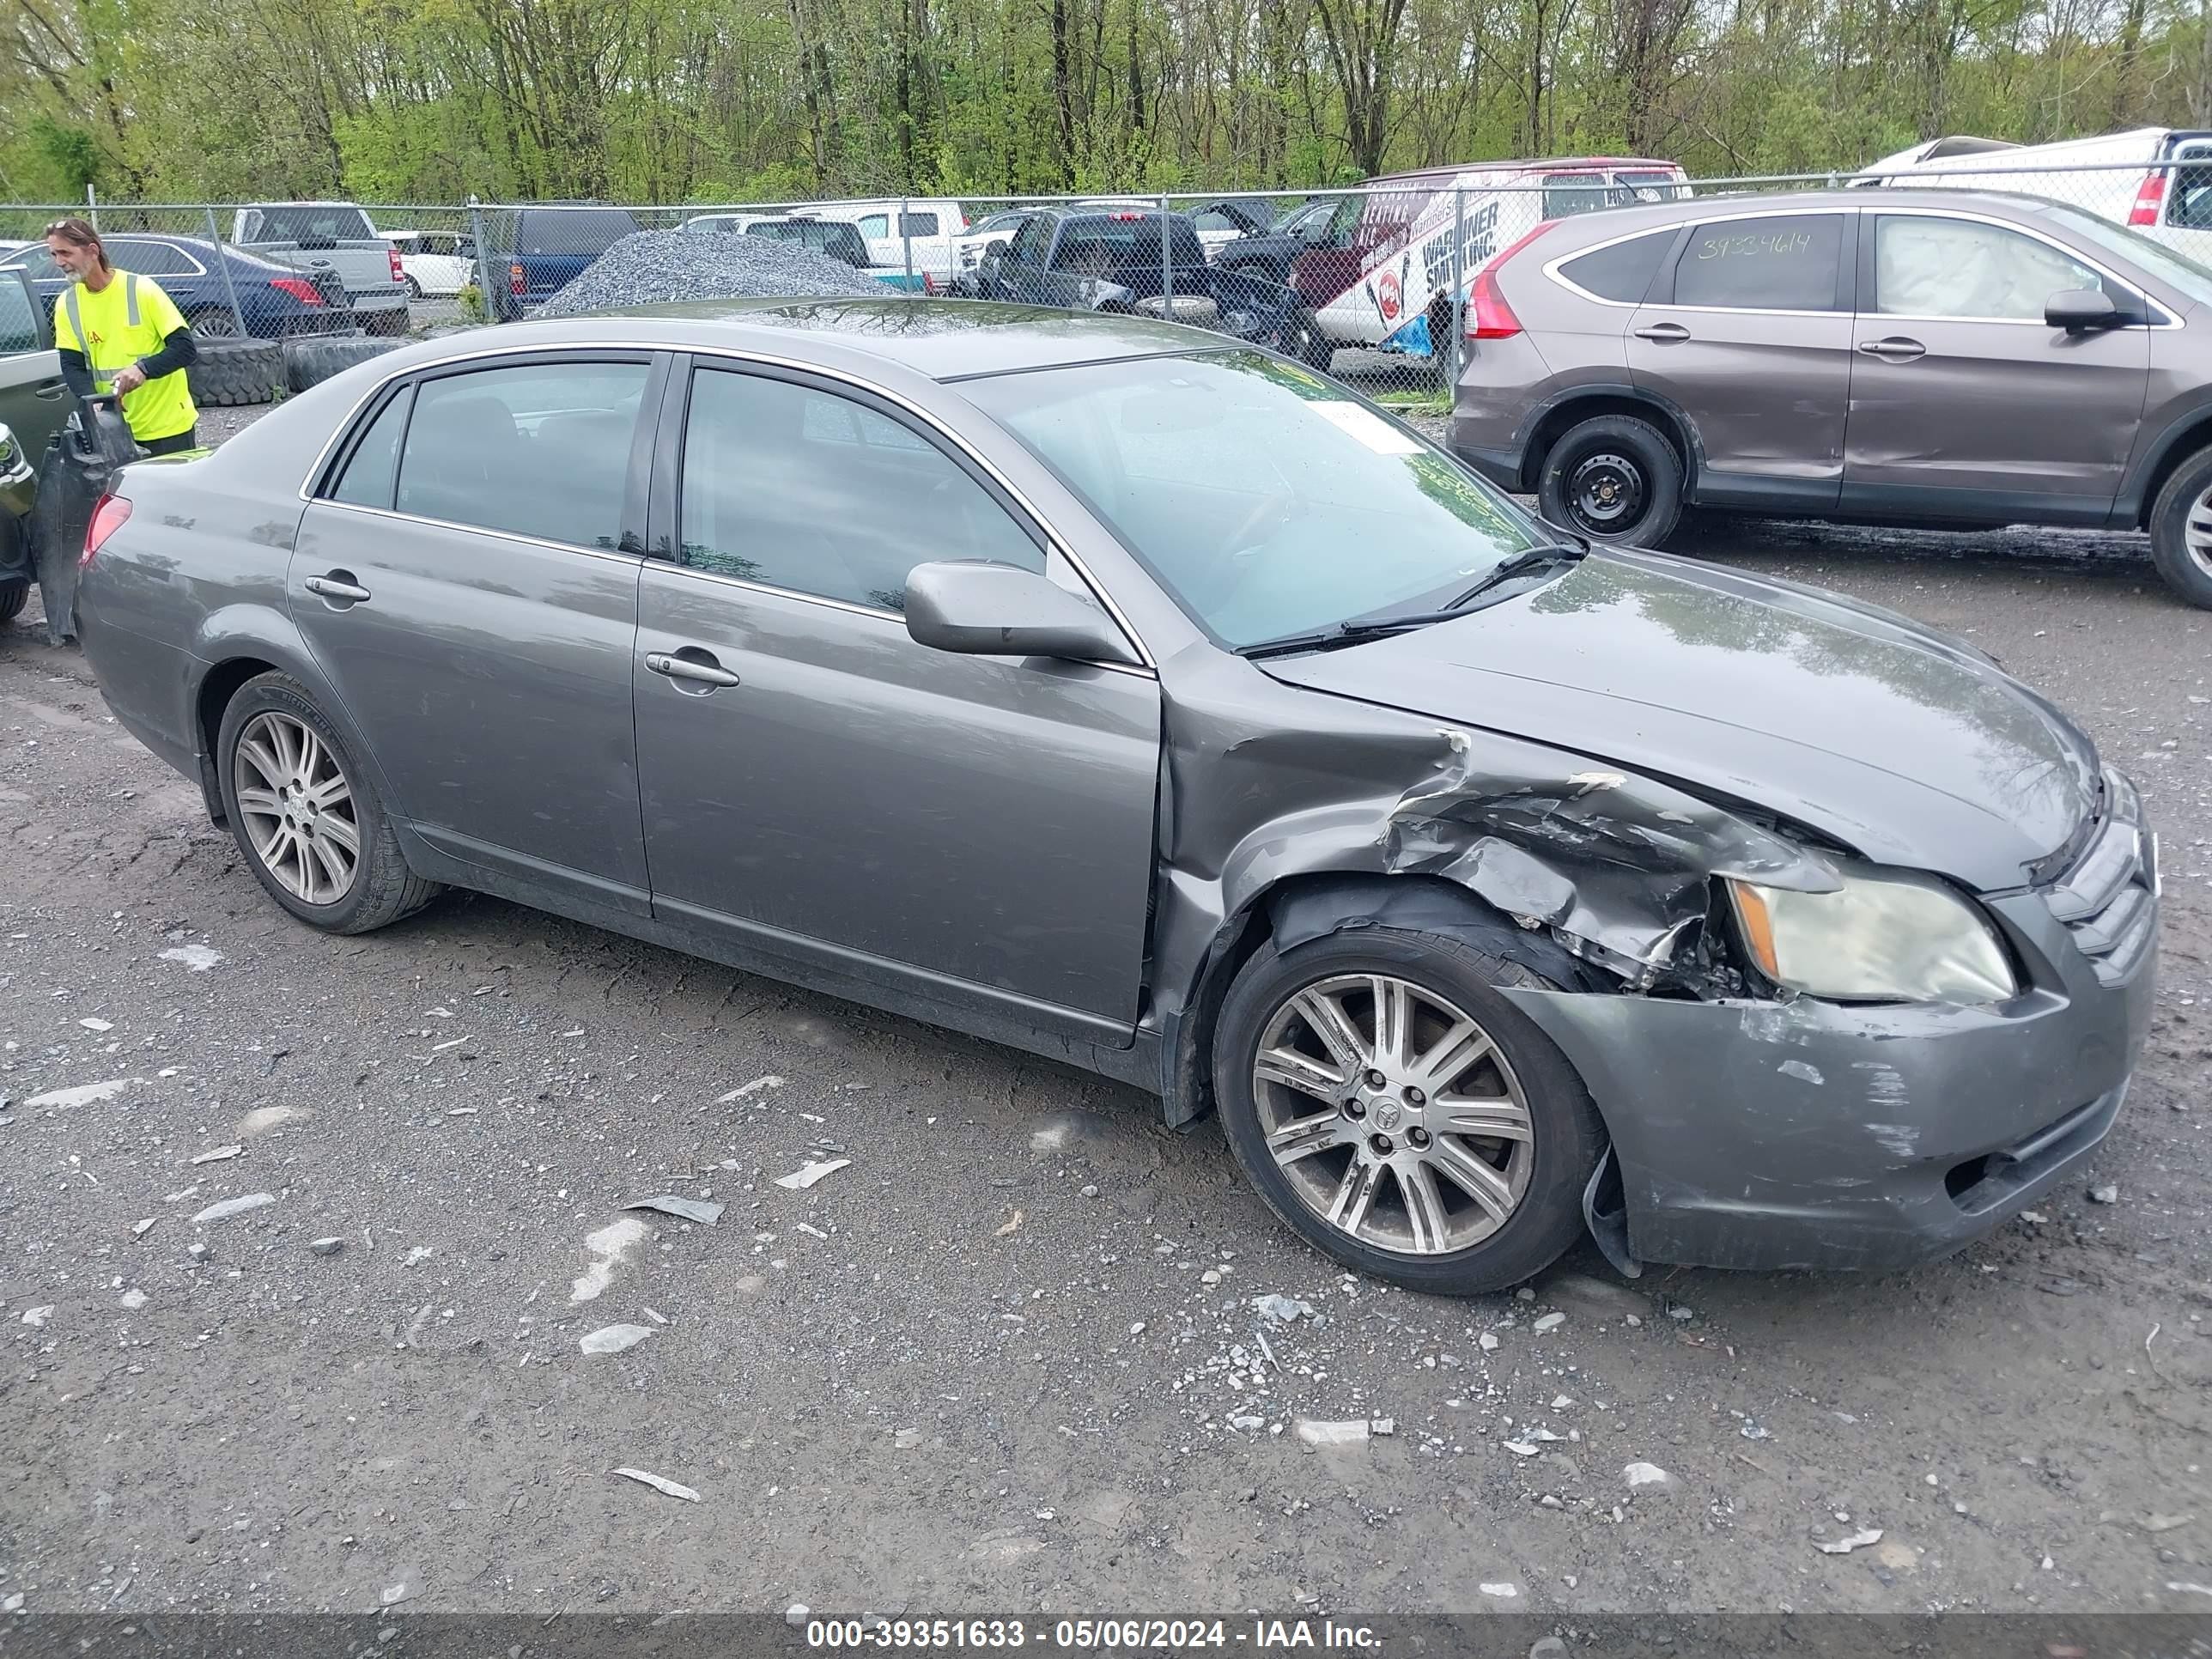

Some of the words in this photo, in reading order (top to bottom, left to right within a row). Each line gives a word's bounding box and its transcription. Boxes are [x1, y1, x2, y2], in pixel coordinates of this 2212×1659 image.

[1362, 204, 1409, 224] HEATING
[1358, 227, 1377, 246] A/C
[1423, 200, 1499, 269] WARINER
[1469, 230, 1498, 268] INC.
